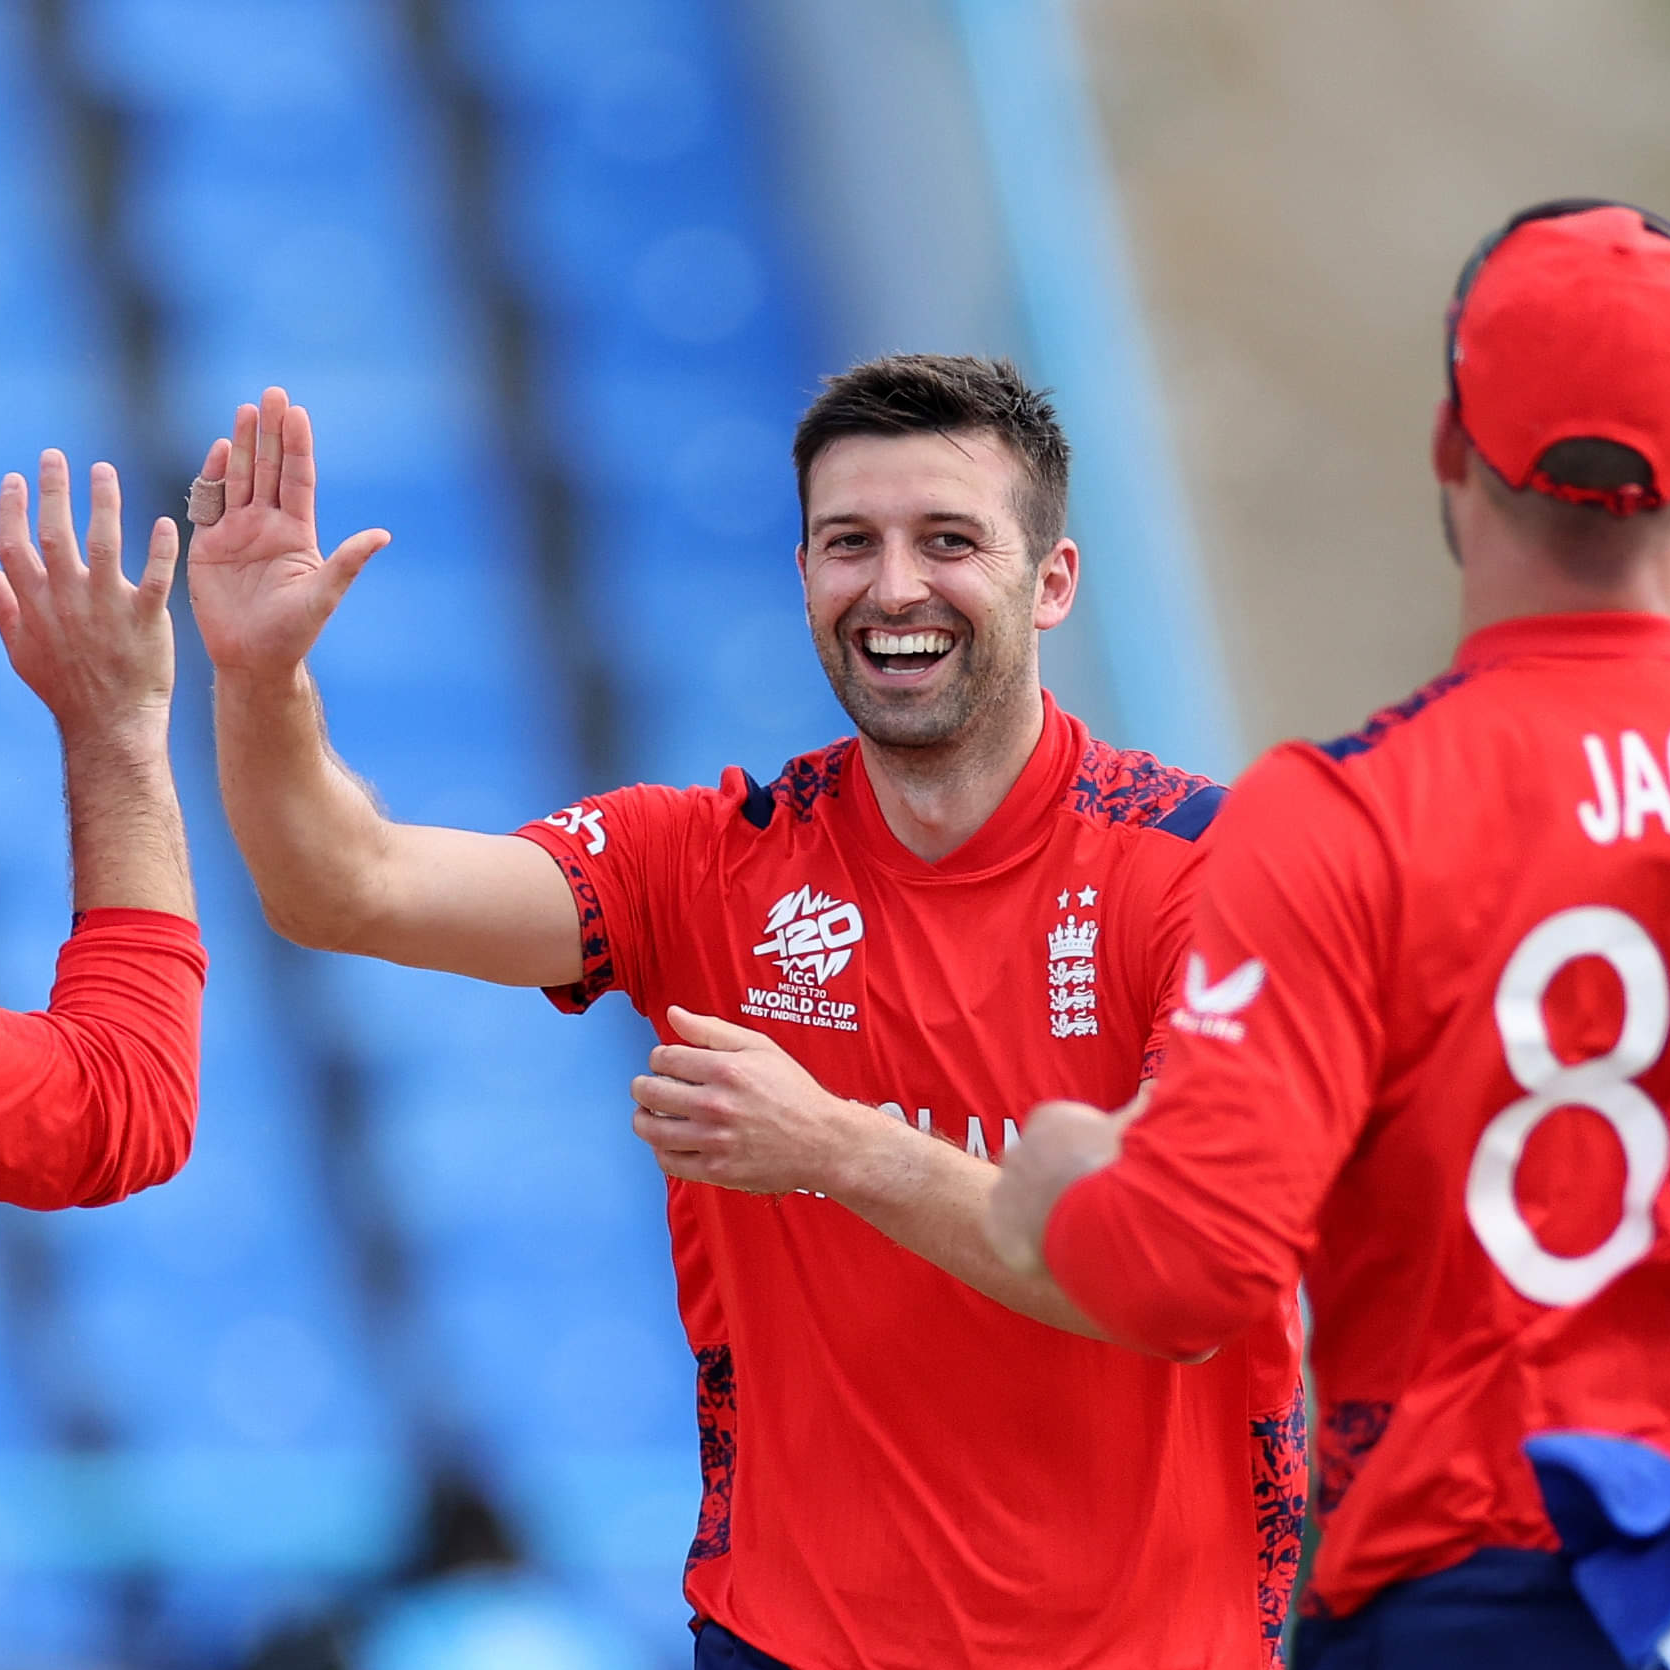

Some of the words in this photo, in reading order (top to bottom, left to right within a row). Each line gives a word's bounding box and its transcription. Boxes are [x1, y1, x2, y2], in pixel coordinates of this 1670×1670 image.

[788, 970, 816, 986] ICC
[778, 982, 807, 996] MEN'S
[808, 987, 827, 999] T20
[747, 987, 815, 1014] WORLD
[817, 1000, 856, 1019] CUP
[740, 1003, 769, 1018] WEST
[770, 1009, 802, 1024] INDIES
[802, 1014, 811, 1025] &
[812, 1016, 833, 1028] USA
[833, 1020, 859, 1032] 2024
